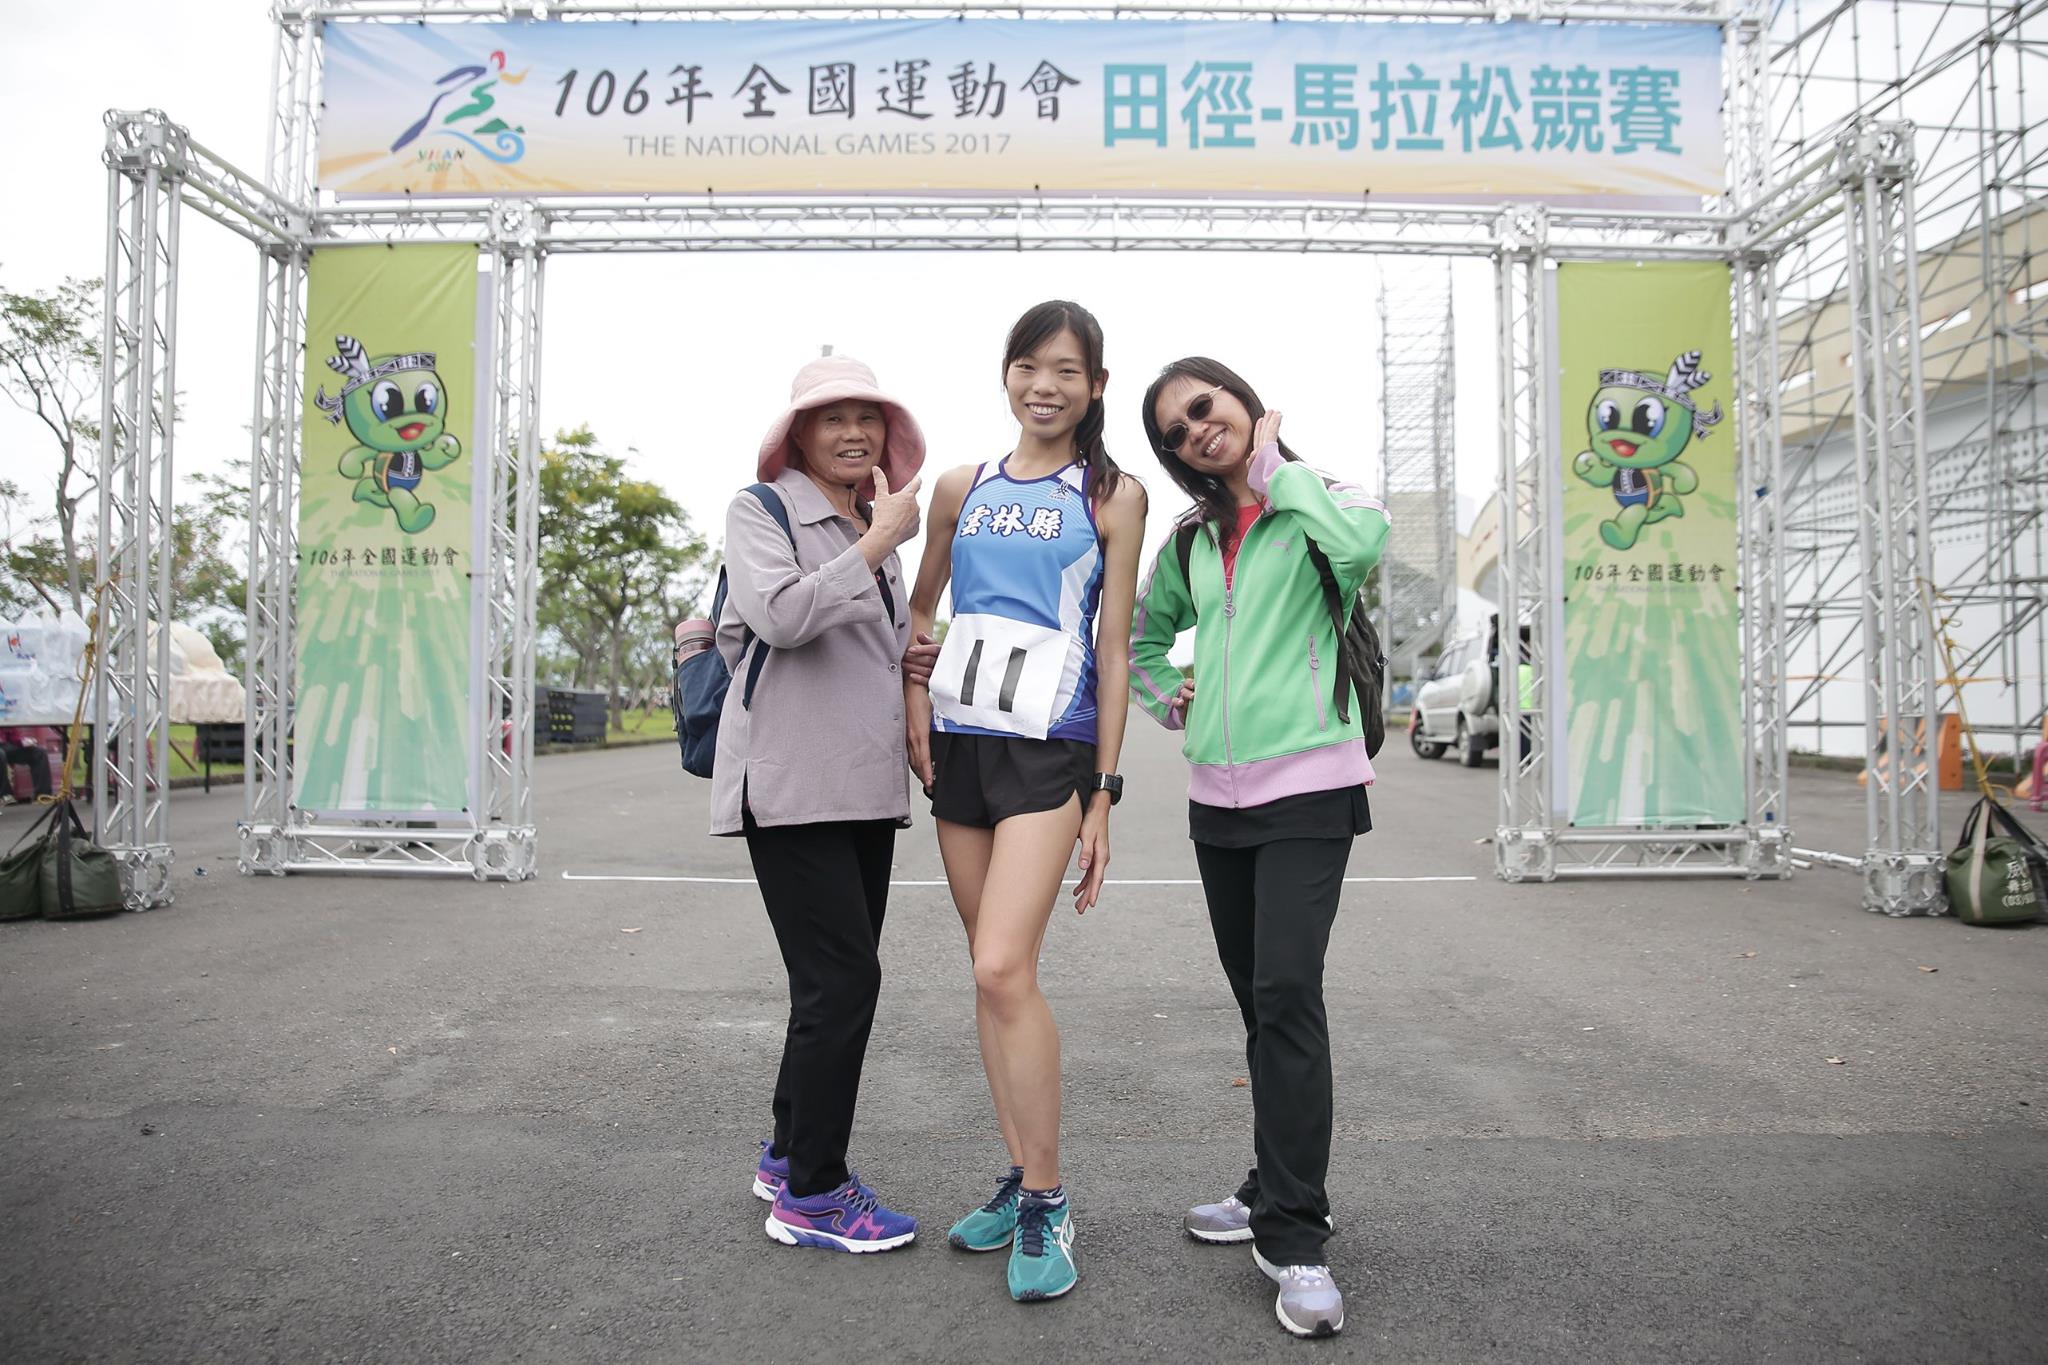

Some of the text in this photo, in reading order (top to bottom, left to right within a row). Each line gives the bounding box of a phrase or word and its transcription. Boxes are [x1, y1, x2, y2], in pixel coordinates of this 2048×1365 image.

[555, 58, 1683, 155] 106年全國運動會 田徑-馬拉松競賽
[624, 133, 1011, 156] THE NATIONAL GAMES 2017
[960, 503, 1063, 541] 雲林縣
[310, 546, 459, 567] 106年全國運動會
[1574, 563, 1725, 583] 106年全國運動會
[960, 639, 1027, 713] 11
